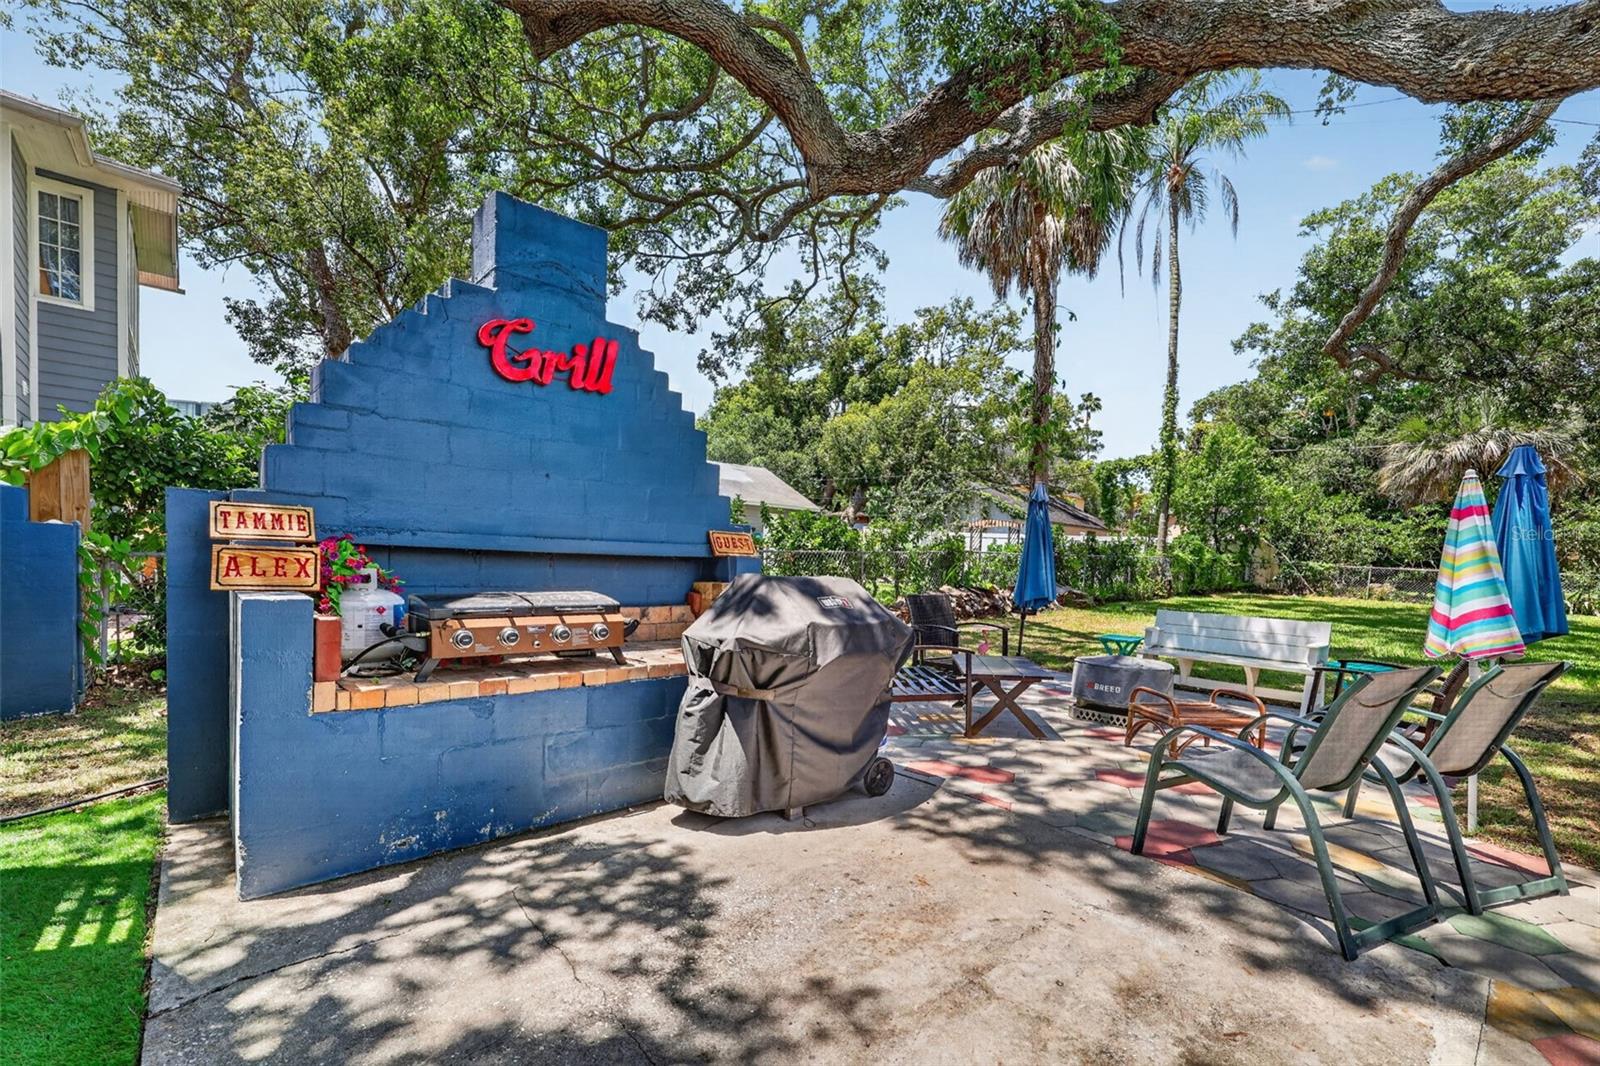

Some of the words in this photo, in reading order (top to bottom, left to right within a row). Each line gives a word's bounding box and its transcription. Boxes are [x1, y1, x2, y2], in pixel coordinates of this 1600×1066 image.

[478, 318, 619, 394] Grill
[219, 510, 307, 531] TAMMIE
[715, 536, 751, 550] GUEST
[222, 556, 311, 578] ALEX
